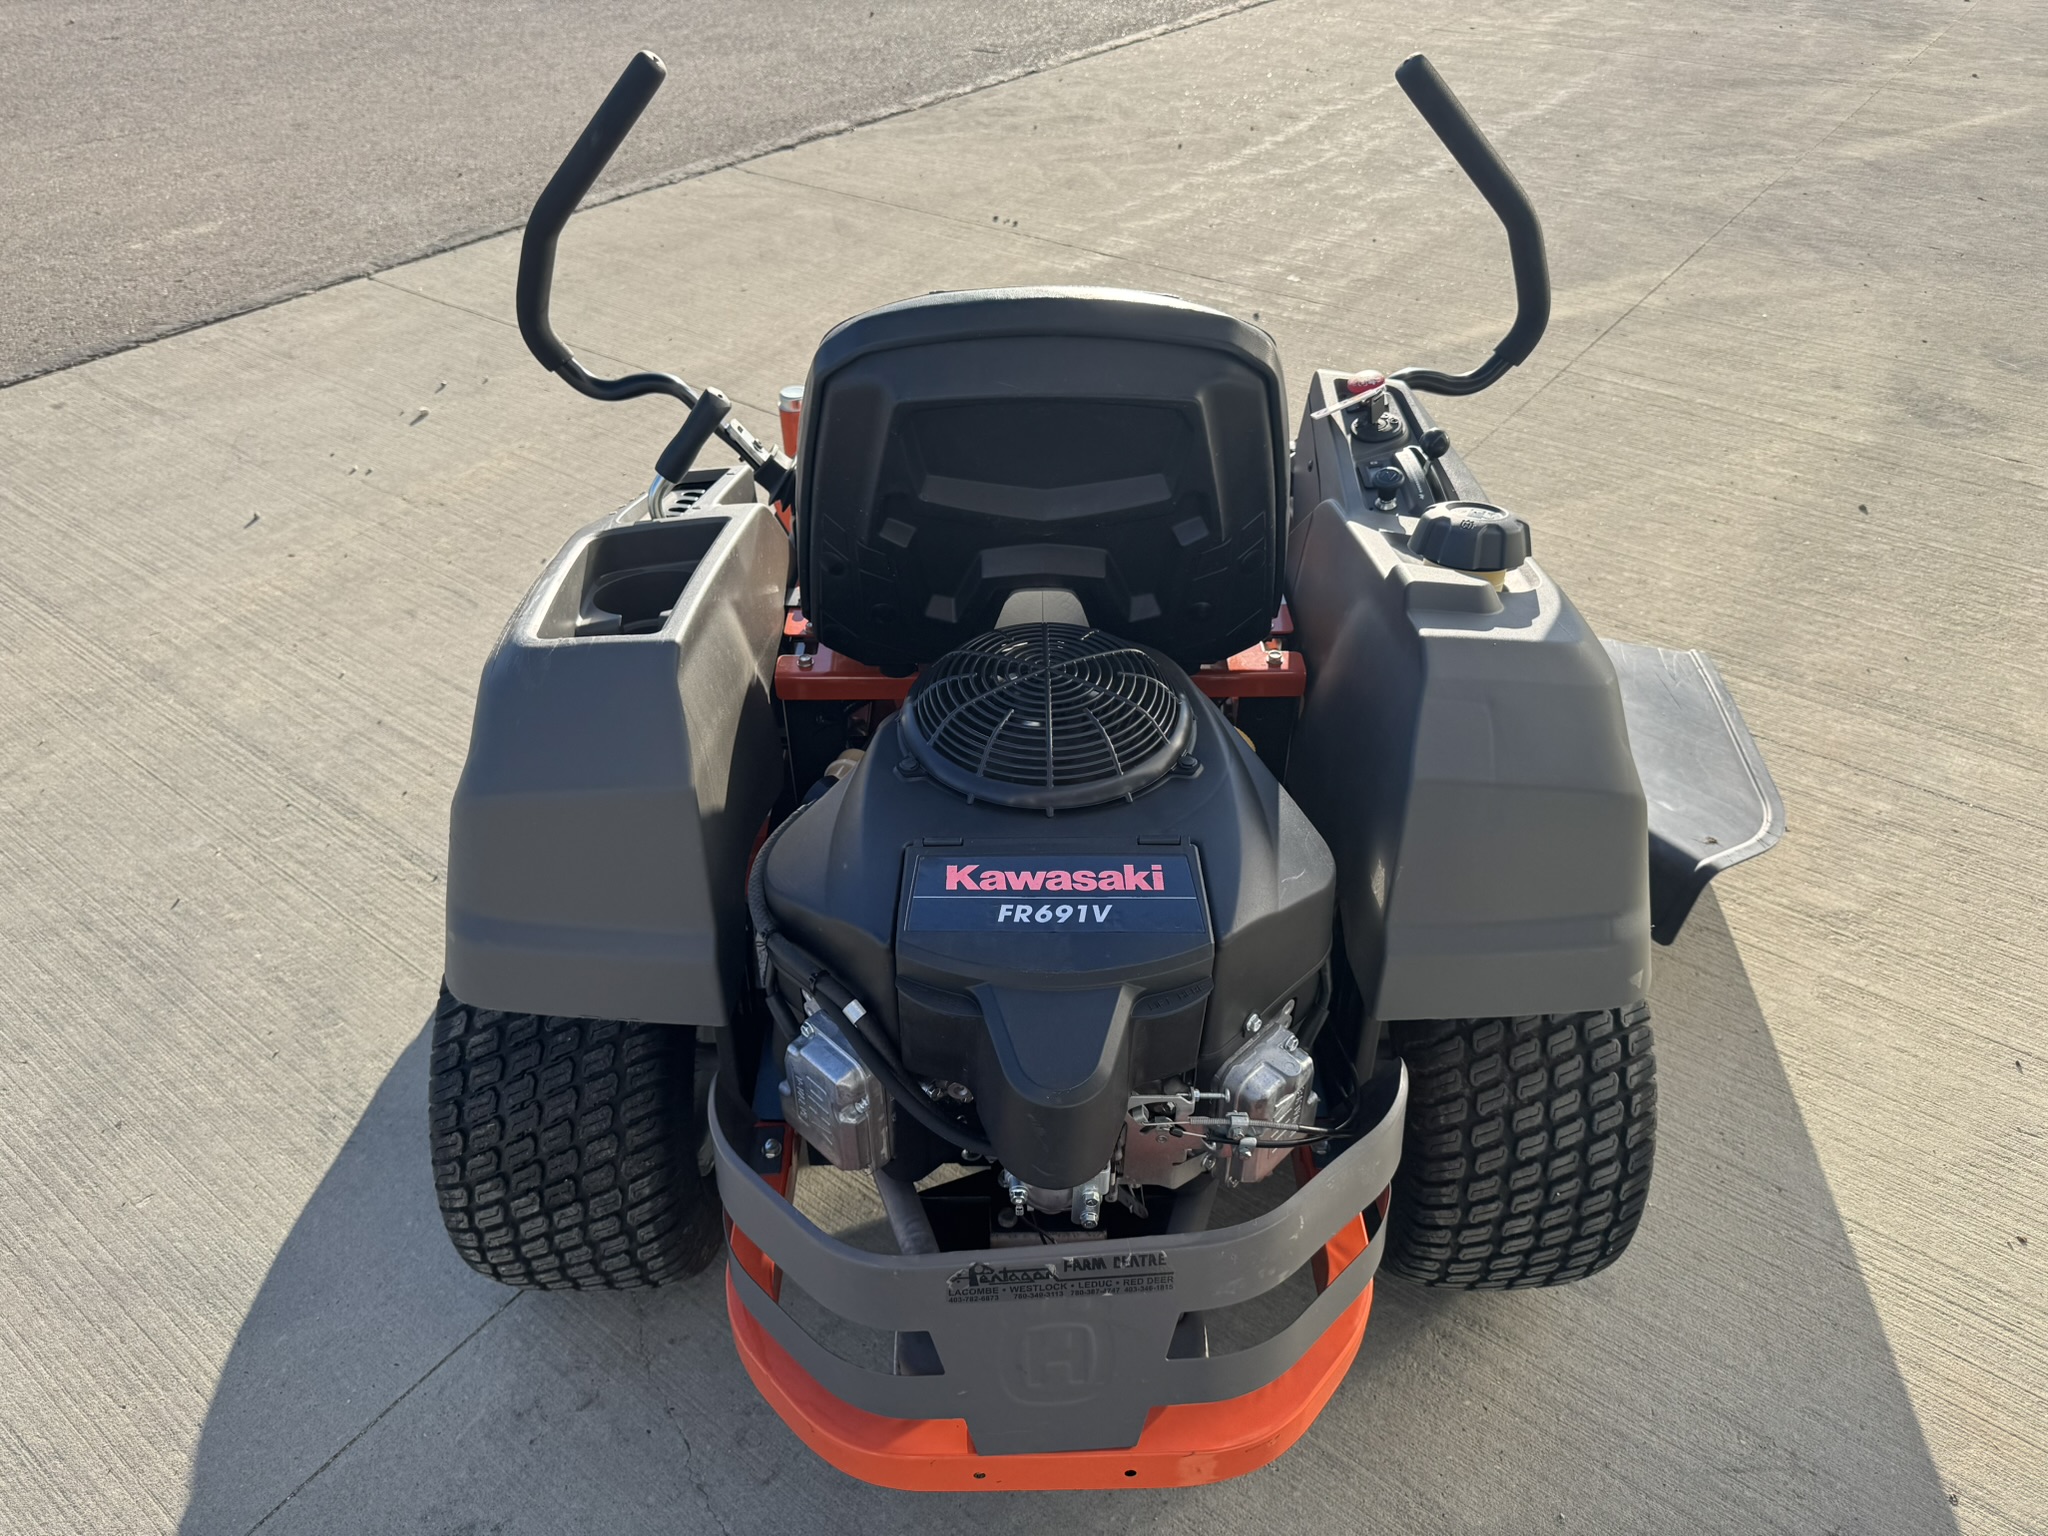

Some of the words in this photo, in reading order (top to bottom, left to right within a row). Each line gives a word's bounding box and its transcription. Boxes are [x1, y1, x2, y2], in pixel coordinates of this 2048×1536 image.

[945, 864, 1165, 891] Kawasaki
[997, 904, 1113, 923] FR691V
[1063, 1256, 1107, 1273] FARM
[948, 1286, 999, 1297] LACOMBE
[1009, 1282, 1068, 1294] WESTLOCK
[1078, 1279, 1113, 1289] LEDUC
[1123, 1277, 1144, 1287] RED
[1146, 1275, 1174, 1285] DEER
